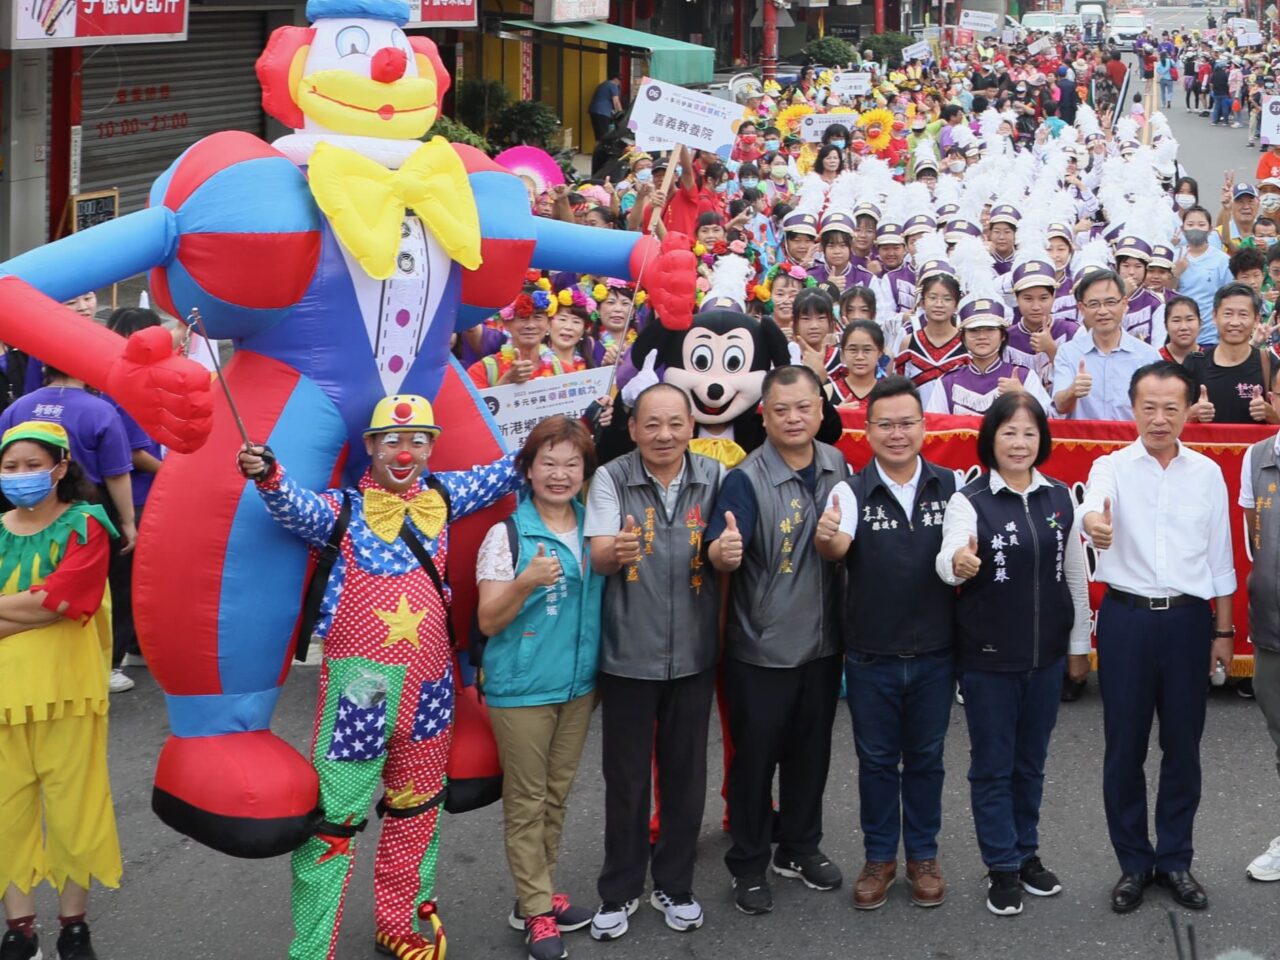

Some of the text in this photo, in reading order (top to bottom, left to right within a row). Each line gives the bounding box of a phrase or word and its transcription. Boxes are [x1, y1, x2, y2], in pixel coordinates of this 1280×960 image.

[648, 89, 659, 98] 06
[1272, 104, 1280, 112] 27
[652, 112, 714, 141] 嘉義教養院
